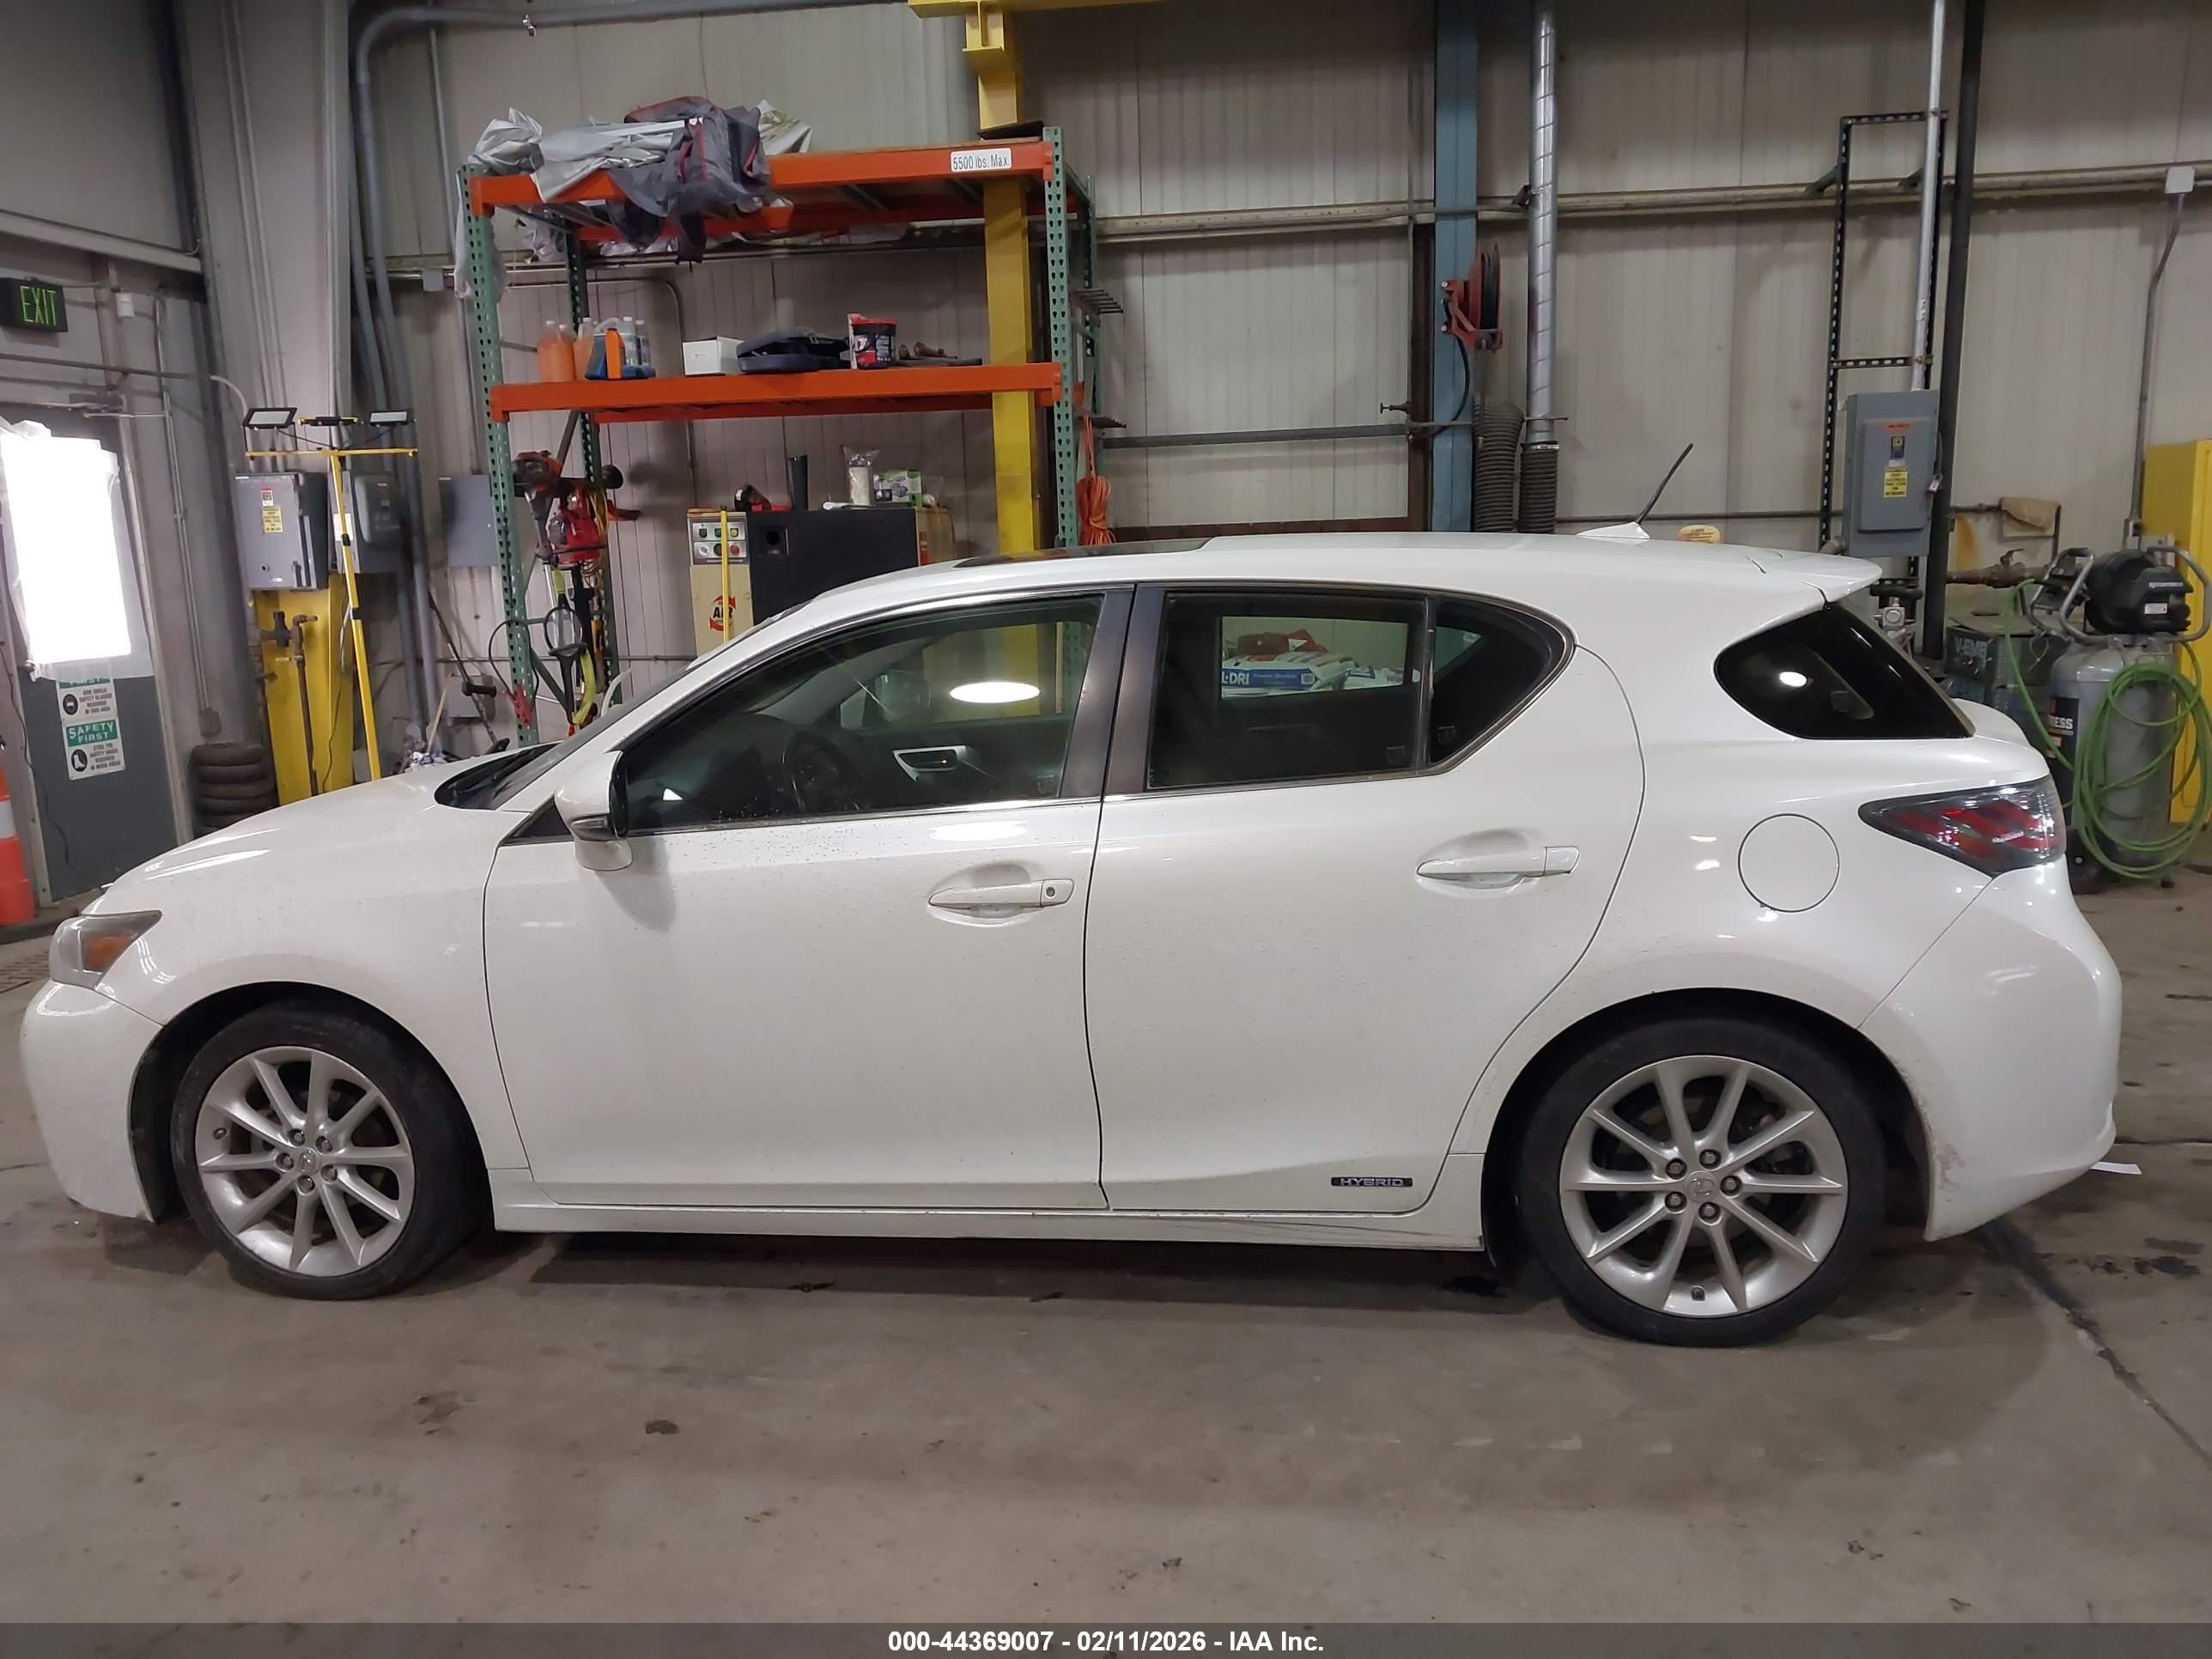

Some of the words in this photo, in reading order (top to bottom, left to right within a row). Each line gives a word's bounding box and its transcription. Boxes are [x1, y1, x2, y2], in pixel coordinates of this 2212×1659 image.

[953, 156, 974, 170] 5500
[975, 155, 990, 168] lbs.
[21, 285, 57, 325] EXIT
[69, 721, 113, 739] SAFETY
[78, 732, 108, 744] FIRST
[1340, 1178, 1404, 1187] HYBRID
